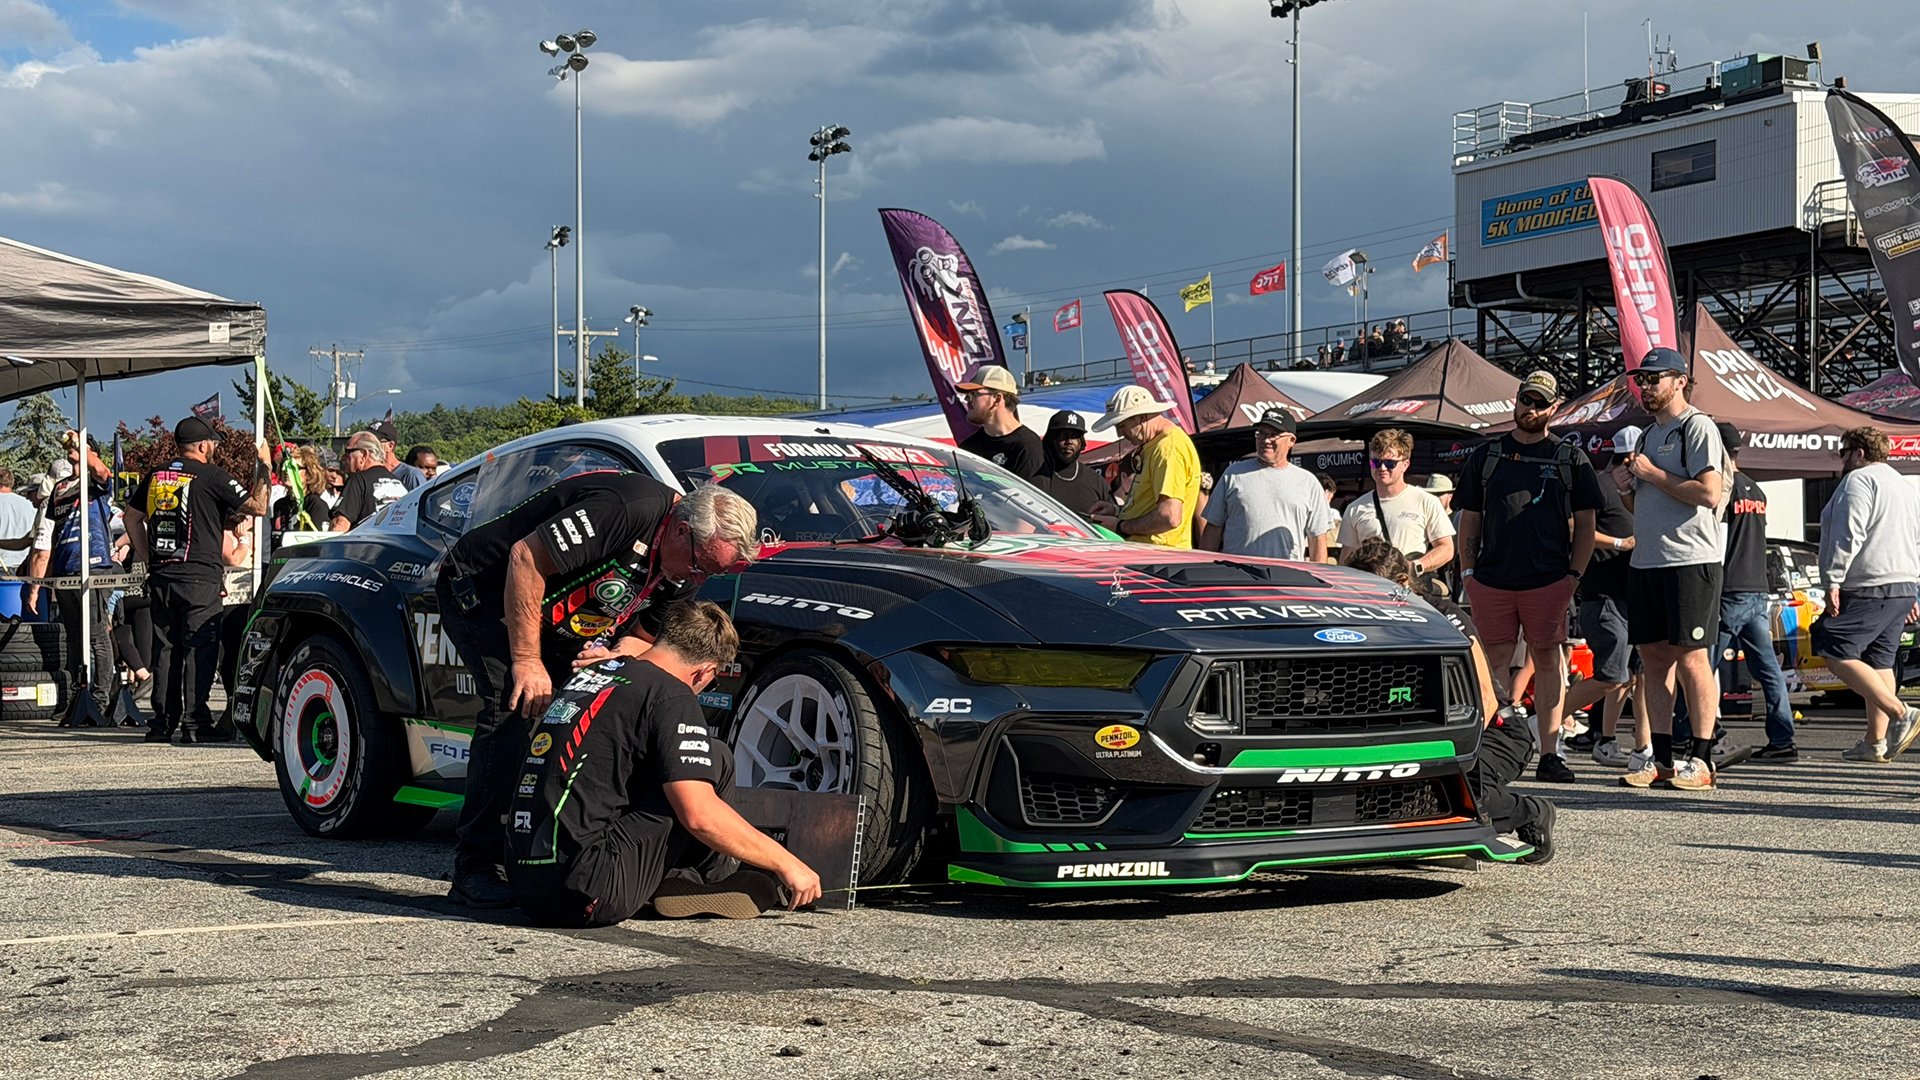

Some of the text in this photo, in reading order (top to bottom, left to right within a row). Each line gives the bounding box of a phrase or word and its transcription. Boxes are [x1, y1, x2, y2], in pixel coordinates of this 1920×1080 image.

[1494, 184, 1594, 217] Home of th
[1486, 218, 1513, 239] SK
[1463, 399, 1517, 416] FORMULA
[763, 442, 863, 458] FORMULA
[1749, 432, 1822, 450] KUMHO
[439, 508, 473, 520] RACING
[387, 561, 413, 575] BC
[324, 571, 384, 593] VEHICLES
[741, 592, 875, 620] NITTO
[1176, 605, 1429, 624] RTR VEHICLES
[414, 612, 465, 667] PEN
[1324, 629, 1359, 643] Ford
[456, 674, 478, 696] ULT
[923, 698, 973, 714] BC
[1100, 732, 1137, 744] PENNZOIL
[1095, 749, 1143, 760] ULTRA PLATINUM
[1277, 762, 1421, 784] NITTO
[1057, 861, 1171, 879] PENNZOIL
